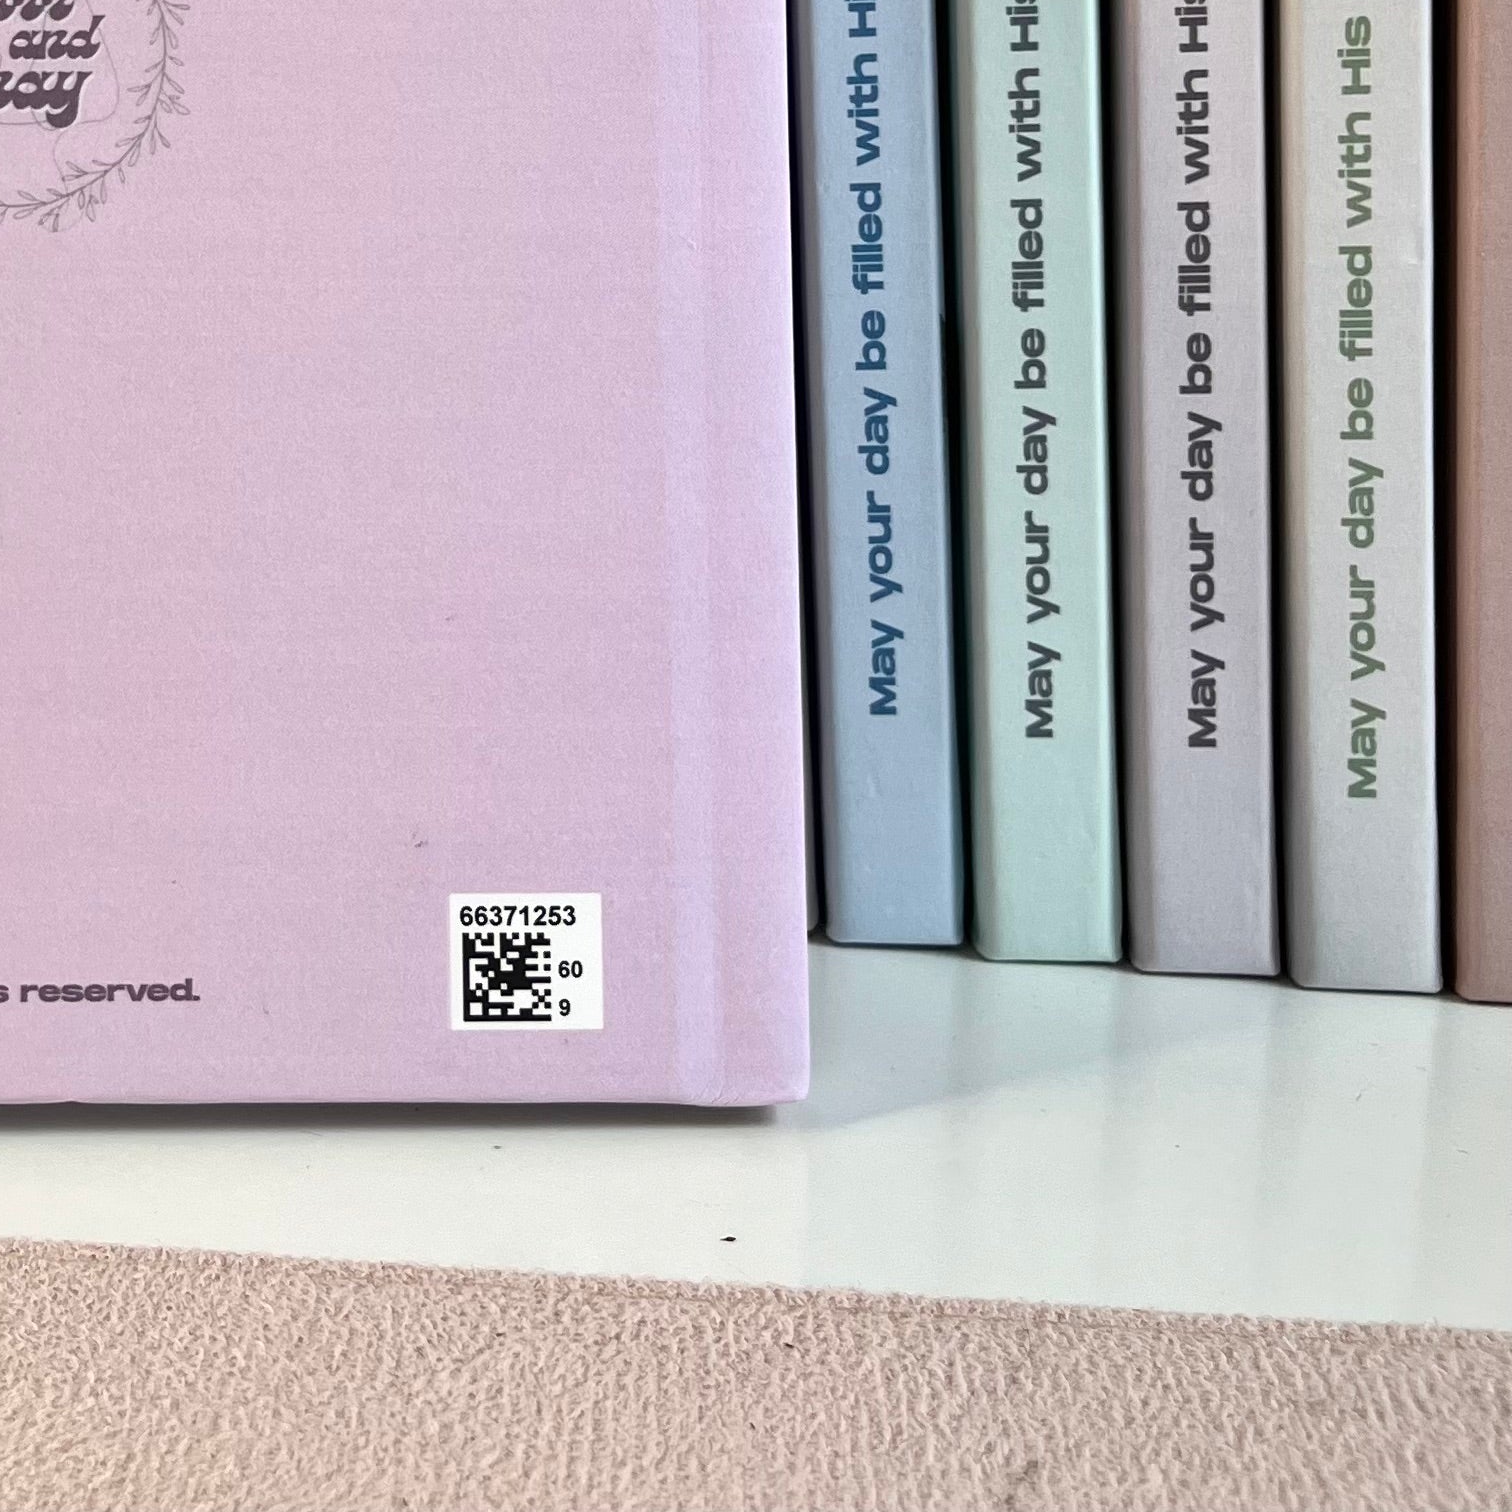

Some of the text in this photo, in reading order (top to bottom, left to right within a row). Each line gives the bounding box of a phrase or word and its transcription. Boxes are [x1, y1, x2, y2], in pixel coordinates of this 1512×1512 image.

[9, 14, 105, 59] and
[1336, 15, 1372, 96] His
[846, 53, 881, 167] with
[1007, 67, 1042, 182] with
[1175, 69, 1210, 185] with
[1337, 111, 1372, 229] with
[849, 182, 885, 295] filled
[1010, 198, 1045, 313] filled
[1177, 201, 1212, 317] filled
[855, 310, 887, 371] be
[1338, 245, 1373, 362] filled
[1013, 328, 1047, 390] be
[1179, 332, 1213, 395] be
[857, 386, 898, 476] day
[1015, 405, 1057, 496] day
[1180, 411, 1223, 502] day
[1339, 377, 1374, 441] be
[866, 490, 904, 603] your
[1340, 457, 1384, 549] day
[1024, 510, 1061, 624] your
[1188, 516, 1225, 632] your
[868, 619, 905, 716] May
[1349, 564, 1386, 681] your
[1024, 641, 1062, 739] May
[1187, 648, 1226, 748] May
[1347, 698, 1387, 799] May
[460, 906, 576, 926] 66371253
[19, 978, 200, 1004] reserved.
[558, 960, 583, 978] 60
[559, 999, 570, 1016] 9
